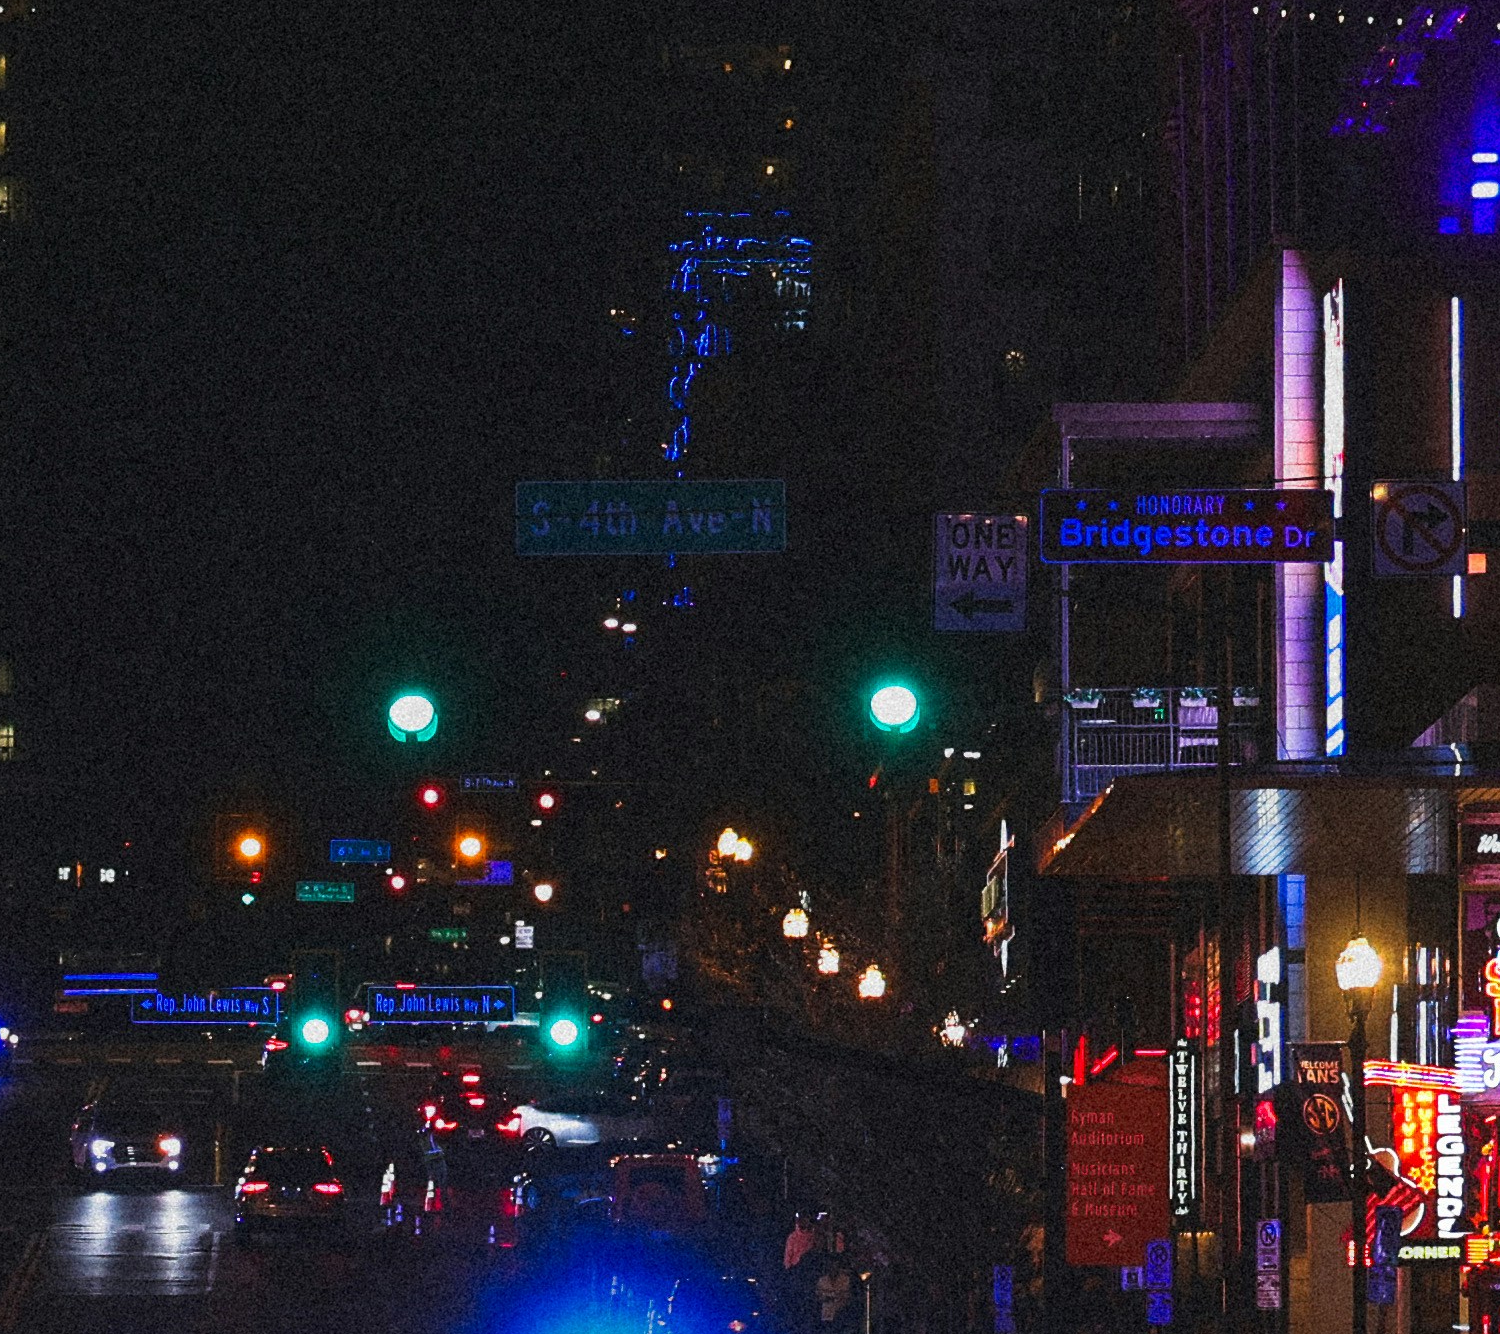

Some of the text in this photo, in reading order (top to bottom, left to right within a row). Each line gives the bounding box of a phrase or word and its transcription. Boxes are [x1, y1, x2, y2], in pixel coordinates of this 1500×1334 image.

[662, 499, 726, 536] Ave
[1136, 495, 1225, 516] HONORARY
[949, 523, 1016, 550] ONE
[1060, 518, 1317, 554] Bridgestone Dr
[947, 556, 1016, 583] WAY
[180, 993, 205, 1013] John
[209, 993, 241, 1013] Lewis
[262, 995, 270, 1014] S
[400, 993, 426, 1013] John
[428, 993, 460, 1013] Lewis
[481, 995, 491, 1013] N
[1071, 1131, 1145, 1146] Auditorium
[1175, 1050, 1189, 1205] TWELVE THIRTY
[1398, 1245, 1461, 1260] ORNER
